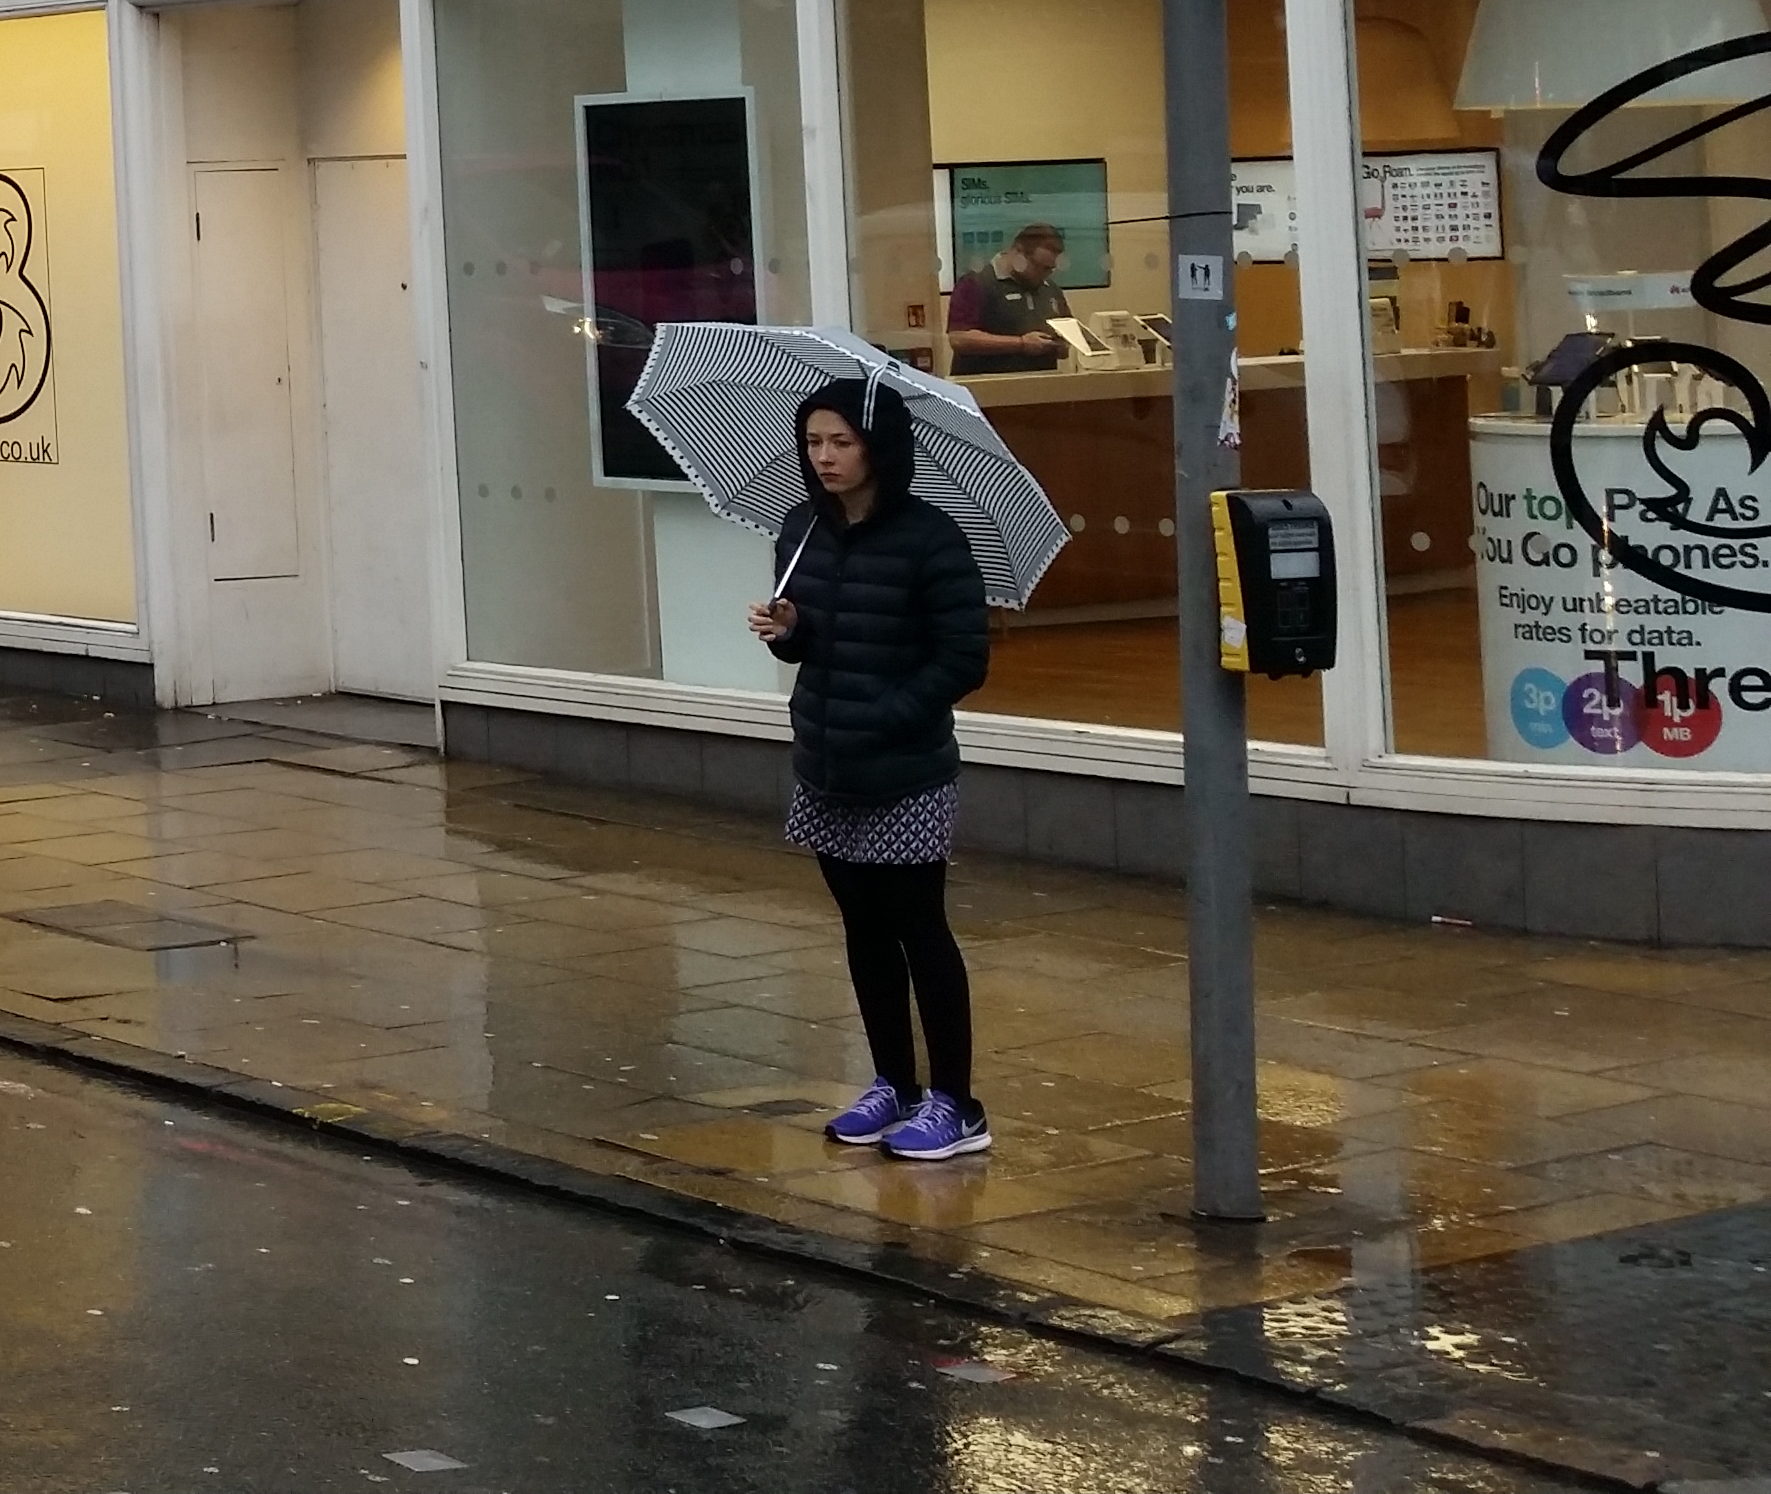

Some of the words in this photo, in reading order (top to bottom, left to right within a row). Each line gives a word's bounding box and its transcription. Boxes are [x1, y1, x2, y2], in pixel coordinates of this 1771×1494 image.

[1235, 184, 1255, 196] you
[1476, 481, 1516, 518] Our
[1705, 486, 1760, 522] As
[1476, 526, 1513, 565] ou
[1521, 531, 1578, 569] Go
[1498, 586, 1554, 616] Enjoy
[1514, 621, 1572, 644] rates
[1578, 623, 1619, 645] for
[1627, 624, 1702, 647] data.
[1523, 682, 1556, 715] 3p
[1662, 727, 1691, 742] MB
